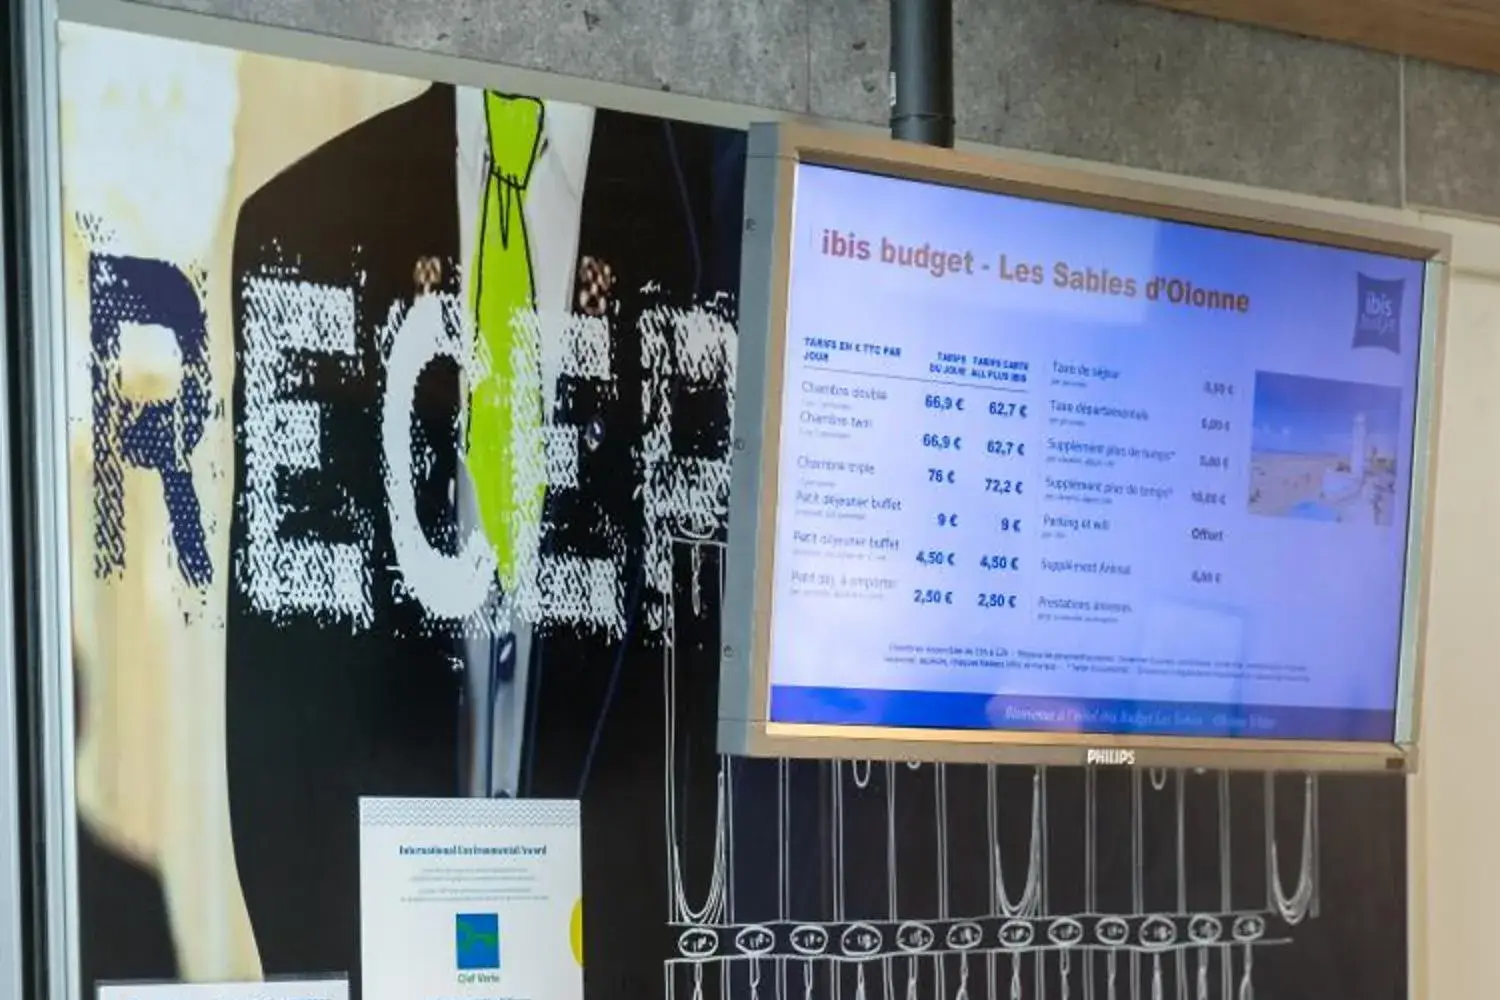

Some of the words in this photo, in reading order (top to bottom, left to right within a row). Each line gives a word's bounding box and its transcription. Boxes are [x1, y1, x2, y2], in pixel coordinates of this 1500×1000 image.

[821, 229, 871, 262] ibis
[880, 235, 974, 280] budget
[999, 254, 1043, 285] Les
[1053, 262, 1136, 298] Sables
[803, 351, 830, 364] JOUR
[955, 398, 966, 412] €
[988, 401, 1017, 417] 62,7
[1018, 404, 1028, 419] €
[922, 433, 951, 450] 66,9
[953, 436, 962, 450] €
[986, 440, 1015, 456] 62,7
[1016, 443, 1026, 457] €
[947, 471, 956, 484] €
[984, 478, 1012, 494] 72,2
[1015, 481, 1024, 494] €
[937, 513, 946, 527] 9
[949, 514, 959, 527] €
[1012, 519, 1022, 532] €
[915, 550, 944, 566] 4,50
[947, 552, 956, 566] €
[979, 555, 1008, 571] 4,50
[1010, 556, 1019, 571] €
[913, 589, 942, 604] 2,50
[944, 591, 953, 605] €
[1008, 594, 1017, 609] €
[1087, 748, 1136, 766] PHILIPS
